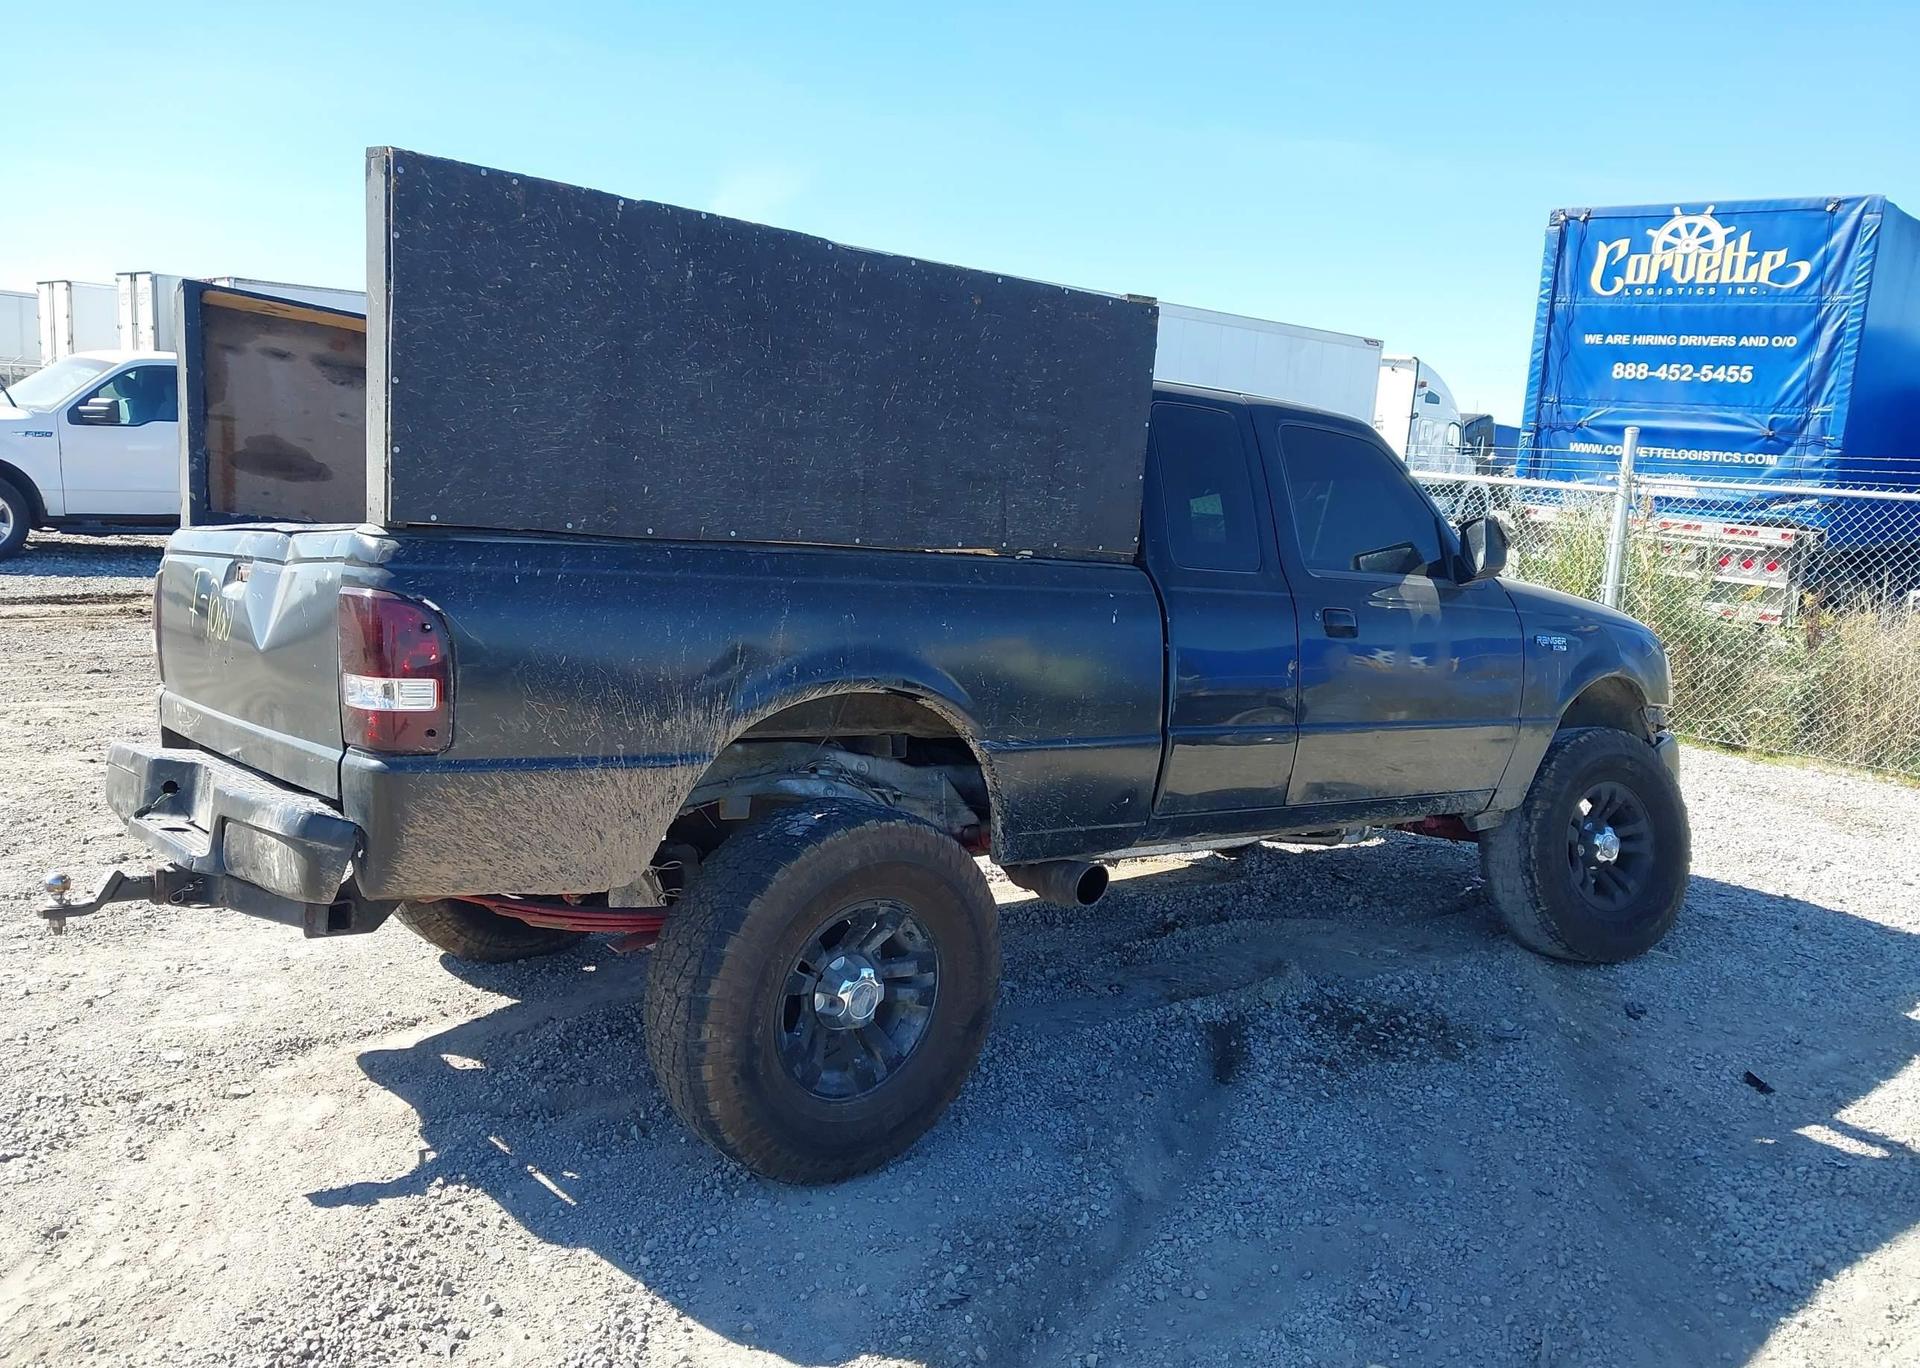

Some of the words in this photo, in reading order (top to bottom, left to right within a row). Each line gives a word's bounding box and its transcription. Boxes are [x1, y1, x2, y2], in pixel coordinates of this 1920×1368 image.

[1590, 231, 1811, 296] Corvette
[1624, 287, 1716, 296] LOGISTICS
[1728, 287, 1767, 295] INC.
[1584, 334, 1604, 345] WE
[1604, 334, 1631, 345] ARE
[1632, 335, 1677, 346] HIRING
[1679, 335, 1737, 347] DRIVERS
[1738, 336, 1769, 347] AND
[1771, 336, 1798, 348] O/O
[1612, 362, 1754, 383] 888-452-5455
[1569, 442, 1778, 465] WWW.COETTELOGISTICS.COM
